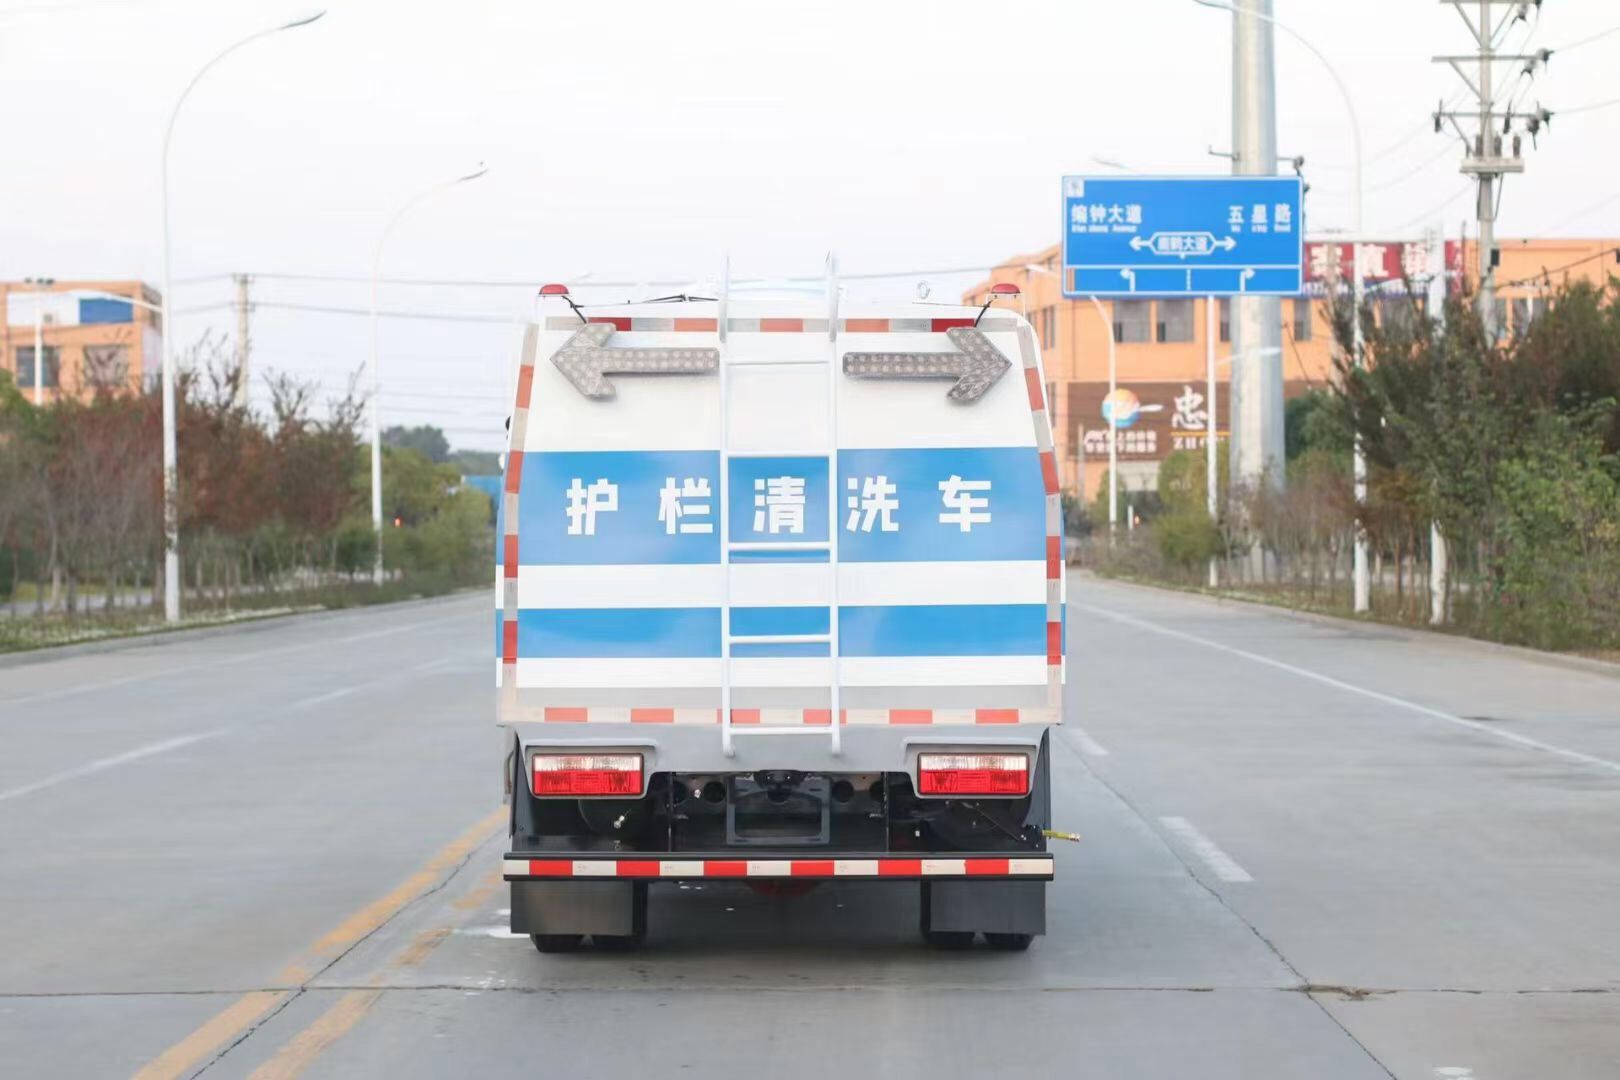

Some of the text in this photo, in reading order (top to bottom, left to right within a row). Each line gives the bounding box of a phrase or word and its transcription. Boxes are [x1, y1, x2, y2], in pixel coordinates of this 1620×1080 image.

[566, 475, 992, 536] 护栏清洗车
